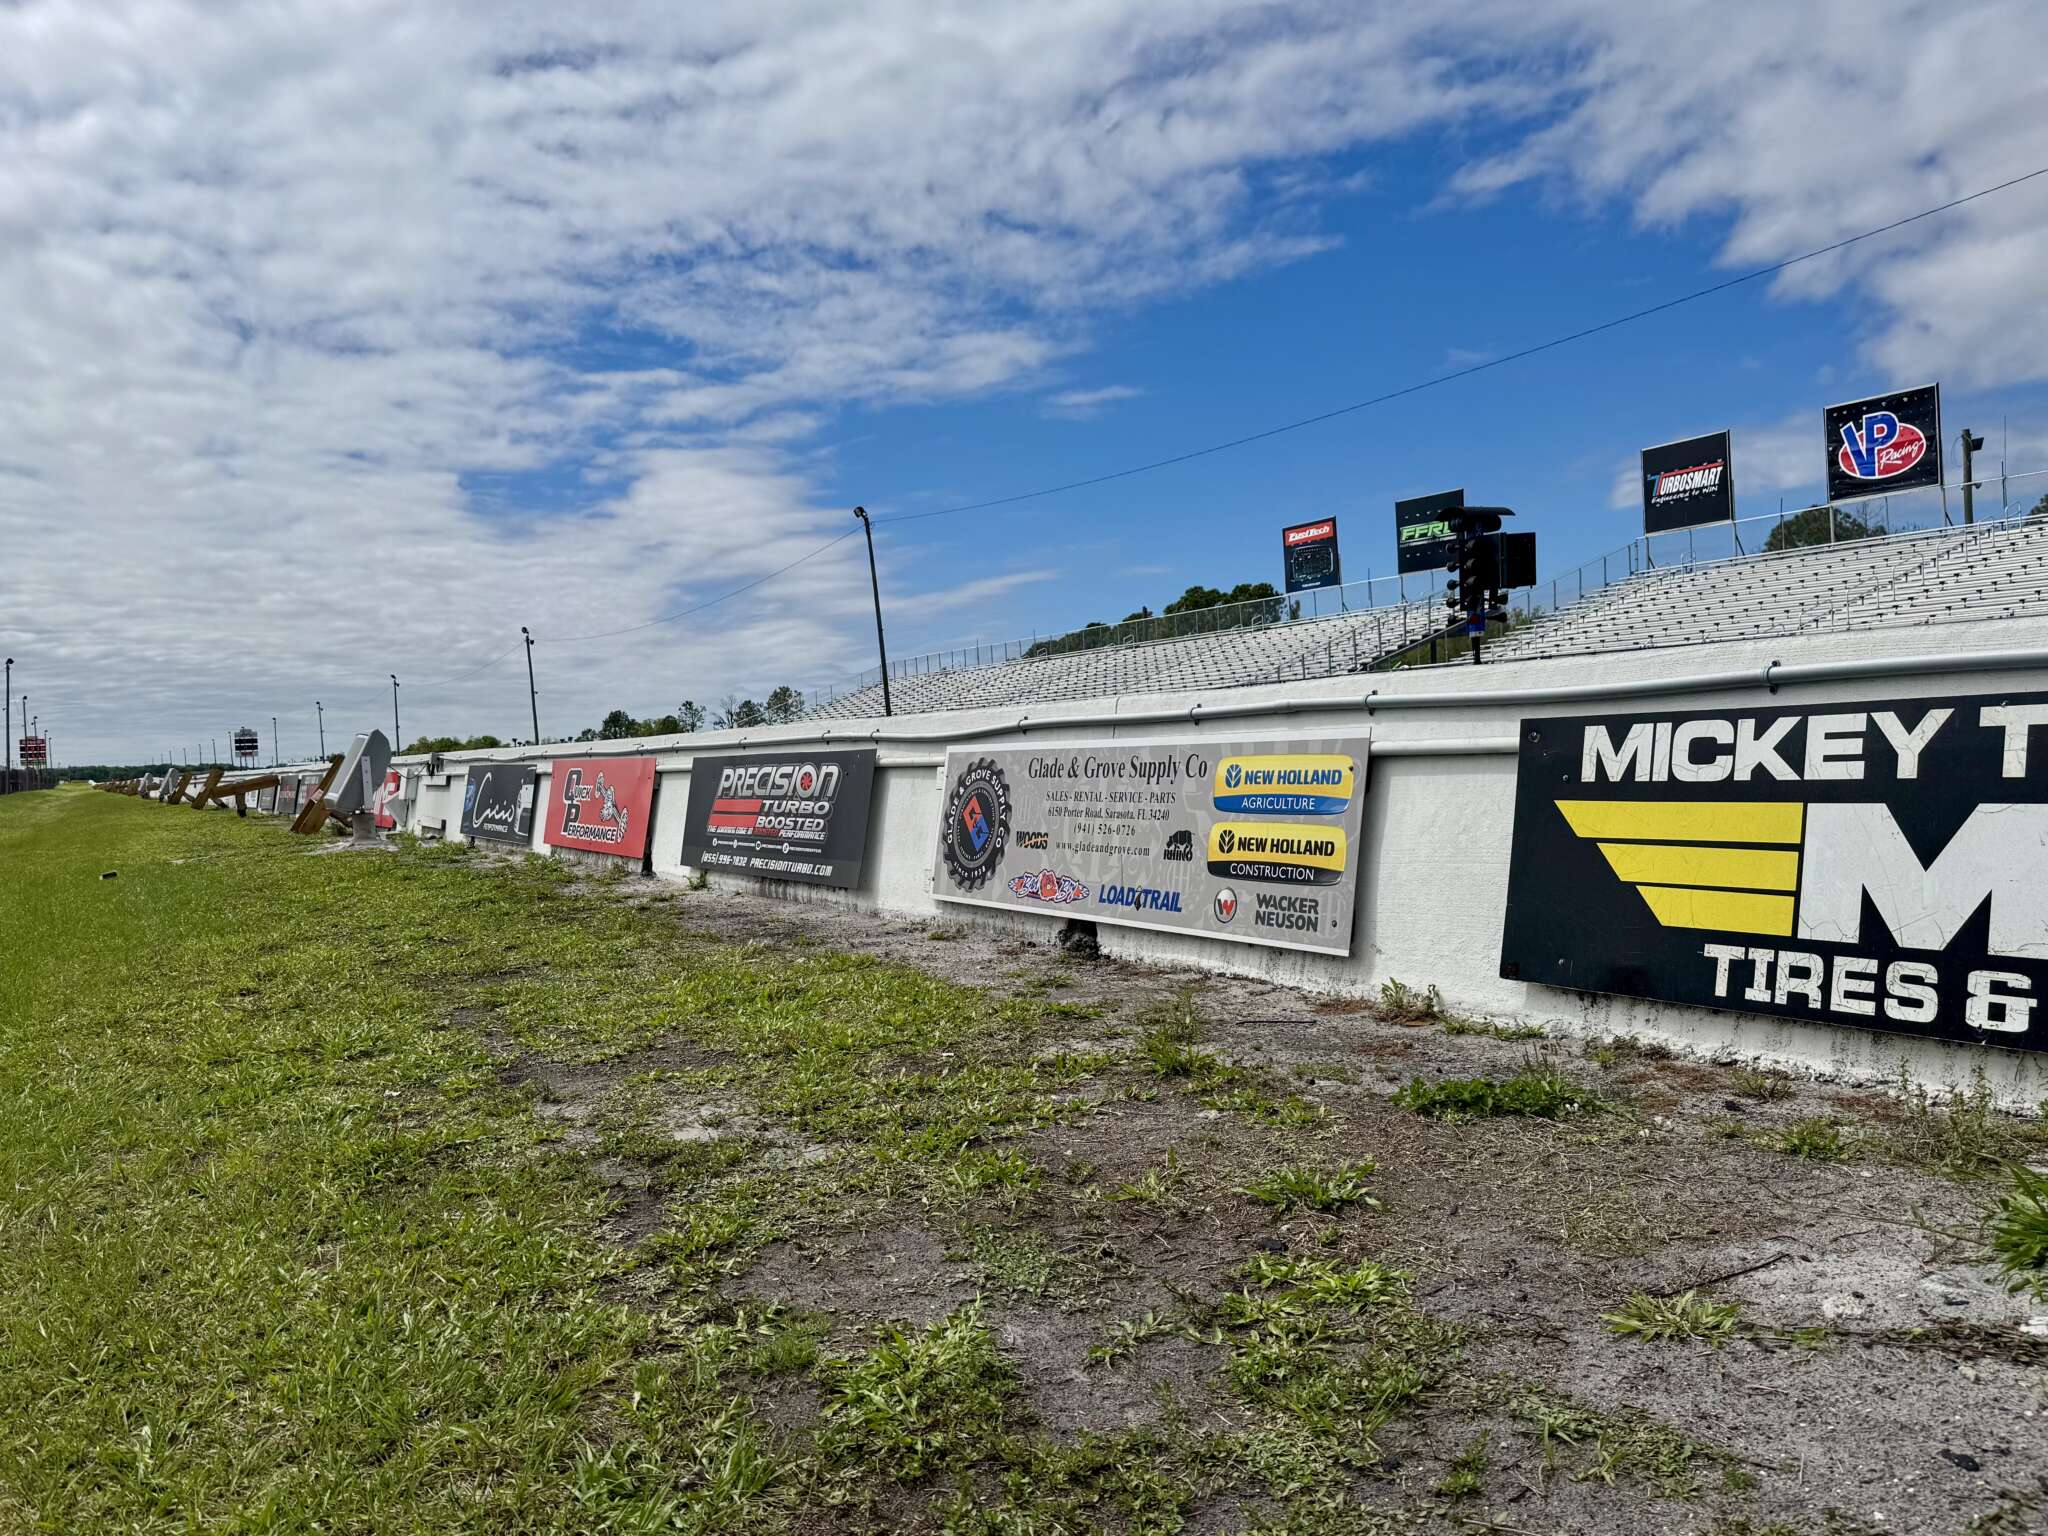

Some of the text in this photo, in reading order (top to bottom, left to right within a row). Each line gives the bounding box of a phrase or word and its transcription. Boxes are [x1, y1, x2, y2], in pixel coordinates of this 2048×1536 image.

[1839, 410, 1900, 479] VP
[1880, 440, 1923, 470] Racing
[1647, 461, 1725, 497] TURBOSMART
[1288, 525, 1330, 543] FuelTech
[1580, 707, 1956, 782] MICKEY
[965, 769, 991, 786] GROVE
[1028, 753, 1208, 785] Glade & Grove Supply Co
[1244, 769, 1343, 785] NEW HOLLAND
[717, 764, 839, 799] PRECISION
[761, 800, 830, 815] TURBO
[992, 775, 1006, 821] SUPPLY
[1046, 790, 1069, 802] SALES
[1073, 791, 1104, 802] RENTAL
[1109, 791, 1143, 804] SERVICE
[1149, 792, 1176, 804] PARTS
[1241, 797, 1316, 810] AGRICULTURE
[561, 802, 618, 842] PERFORMANCE
[755, 816, 824, 831] BOOSTED
[947, 798, 960, 844] GLADE
[1063, 807, 1084, 818] Porter
[1137, 808, 1148, 820] FL
[1149, 809, 1170, 821] 34240
[995, 827, 1005, 848] CO
[1016, 830, 1049, 850] WOODS
[1073, 822, 1136, 837] (941) 526-0726
[1055, 840, 1150, 857] www.gladeandgrove.com
[1237, 836, 1335, 857] NEW HOLLAND
[750, 857, 833, 876] PRECISIONTURBO.COM
[1230, 863, 1315, 881] CONSTRUCTION
[1256, 893, 1319, 915] WACKER
[1255, 910, 1319, 932] NEUSON
[1704, 944, 2037, 1033] TIRES &
